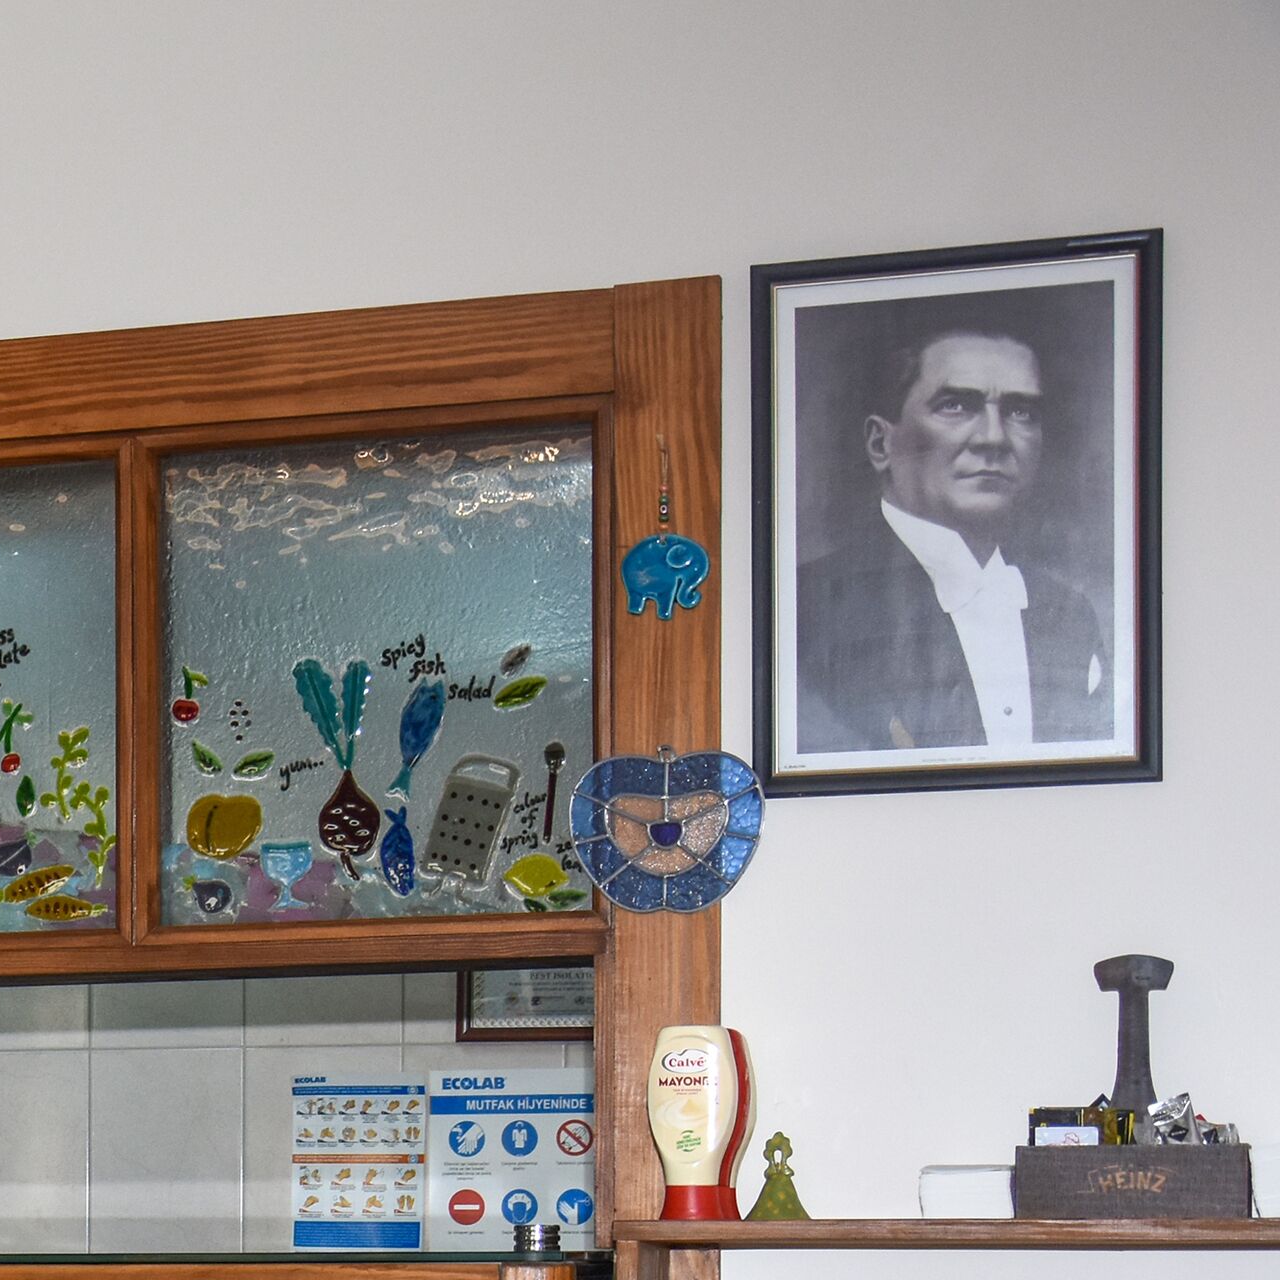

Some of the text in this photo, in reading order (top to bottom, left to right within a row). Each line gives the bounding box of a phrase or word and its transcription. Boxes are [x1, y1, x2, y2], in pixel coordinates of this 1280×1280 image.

[408, 652, 447, 683] fish
[668, 1056, 705, 1068] Calvé
[442, 1076, 506, 1091] ECOLAB
[466, 1096, 587, 1111] MUTFAK HİJYENİNDE
